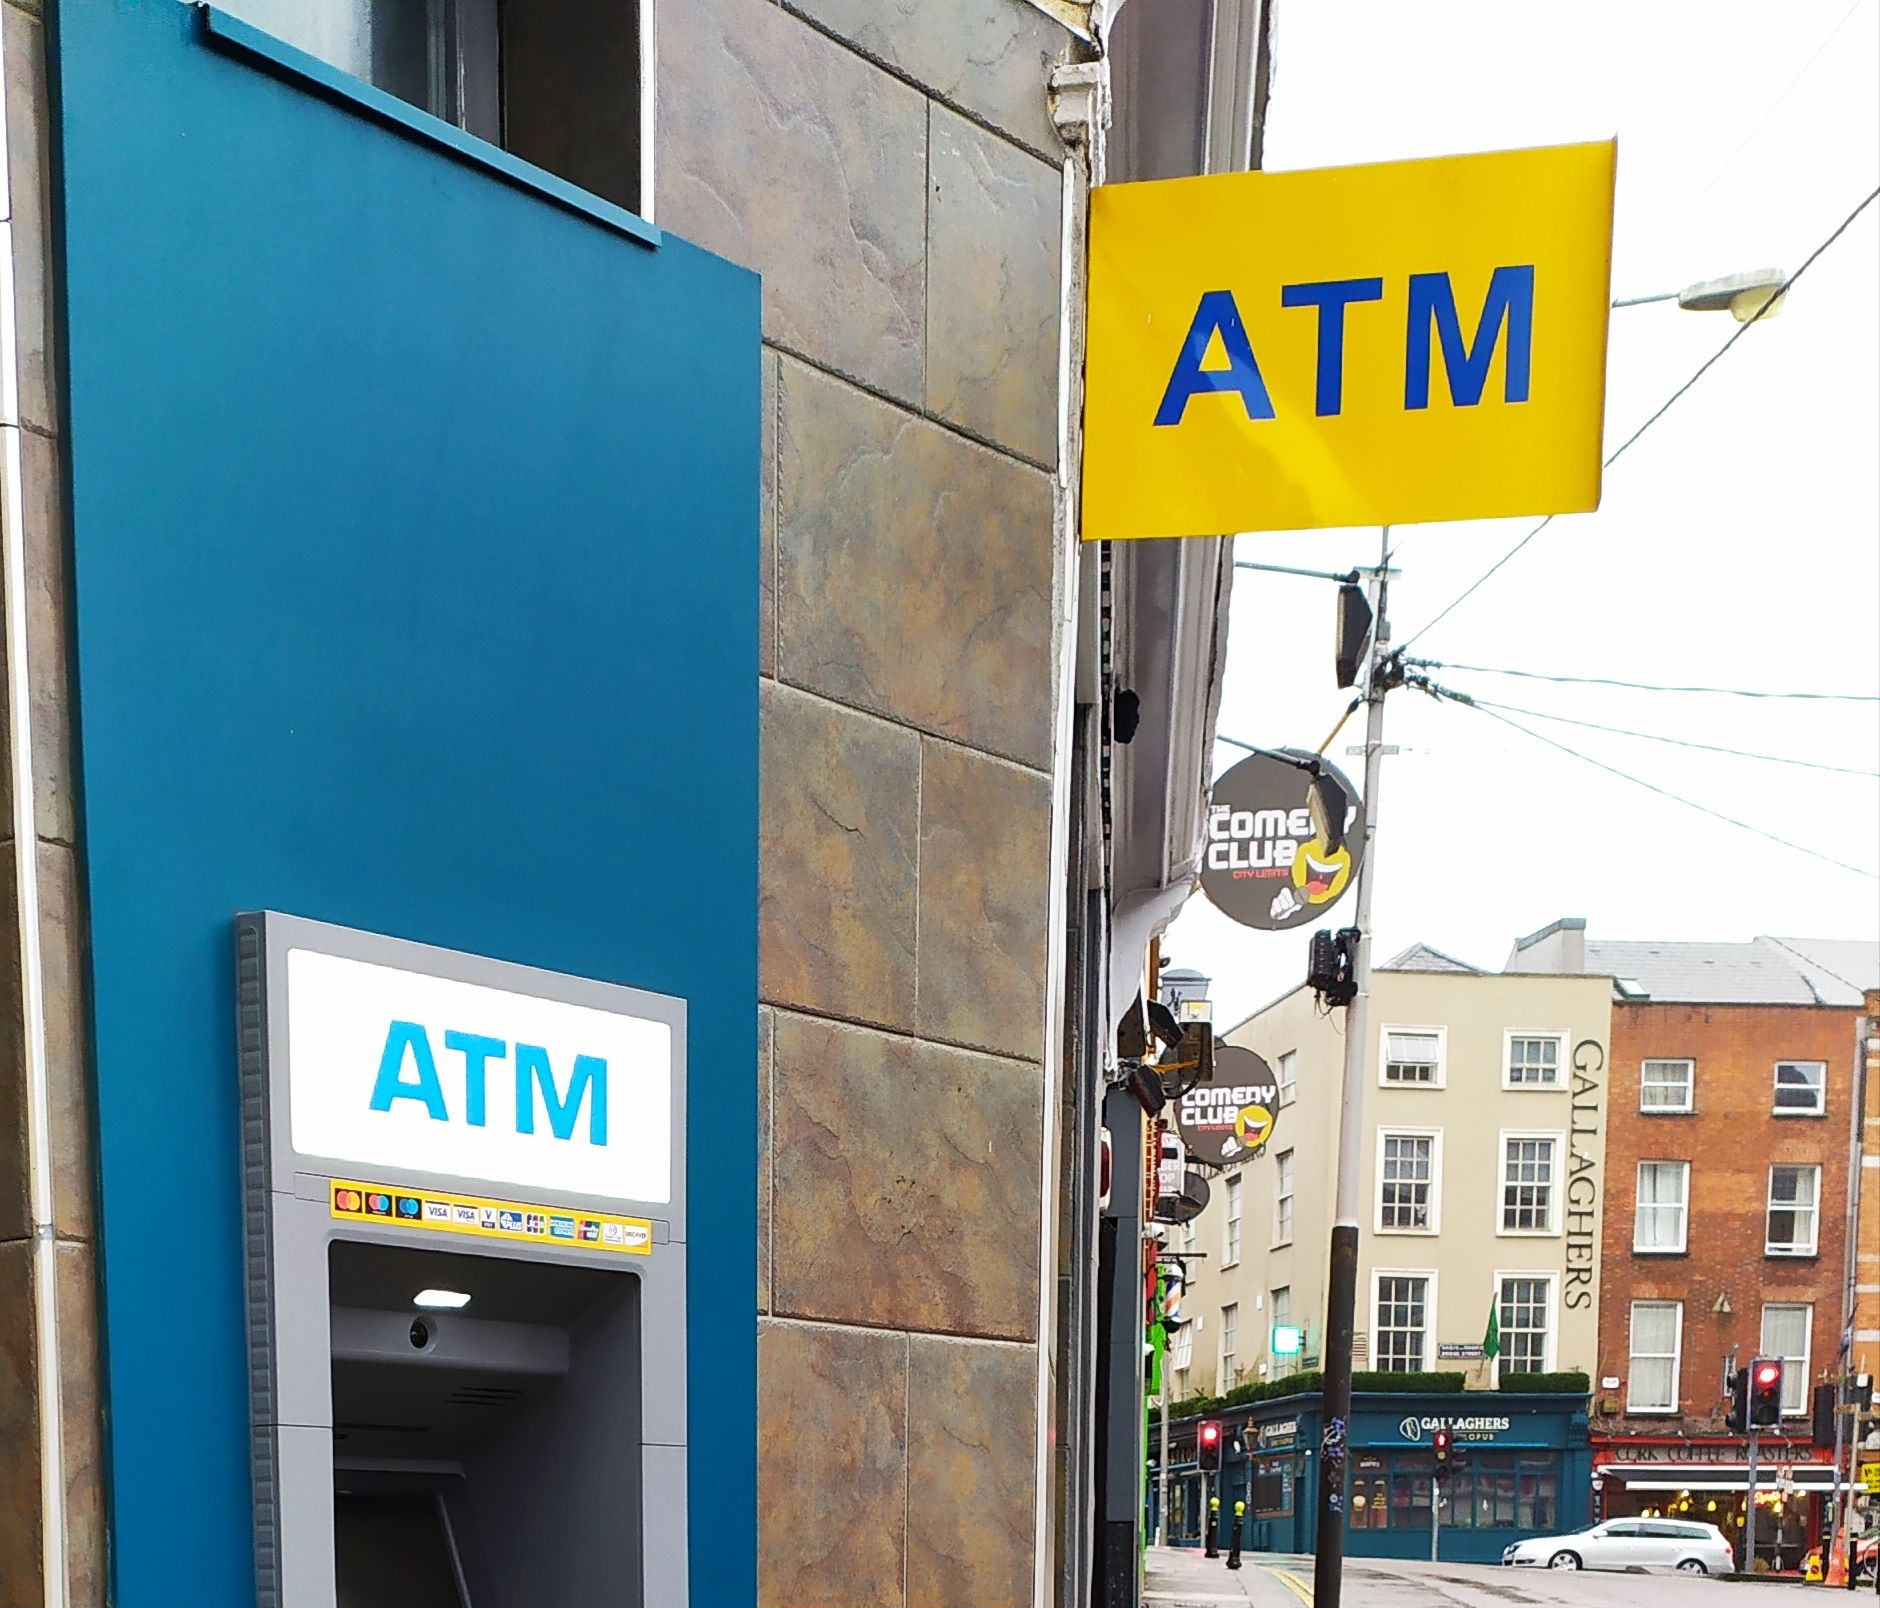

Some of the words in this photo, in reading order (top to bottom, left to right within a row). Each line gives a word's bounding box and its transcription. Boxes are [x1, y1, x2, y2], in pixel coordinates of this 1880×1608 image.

[1155, 266, 1533, 425] ATM
[1210, 803, 1231, 814] THE
[1210, 806, 1357, 841] COMEY
[1208, 840, 1299, 870] CLUB
[370, 1020, 607, 1146] ATM
[1181, 1085, 1276, 1107] COMEDY
[1181, 1106, 1239, 1126] CLUB
[1161, 1160, 1180, 1171] BER
[1565, 1038, 1605, 1310] GALLAGHERS
[1160, 1173, 1176, 1183] OP
[428, 1206, 448, 1217] VISA
[457, 1209, 475, 1220] VISA
[1421, 1416, 1510, 1430] GALLAGHERS
[1616, 1446, 1658, 1461] CORK
